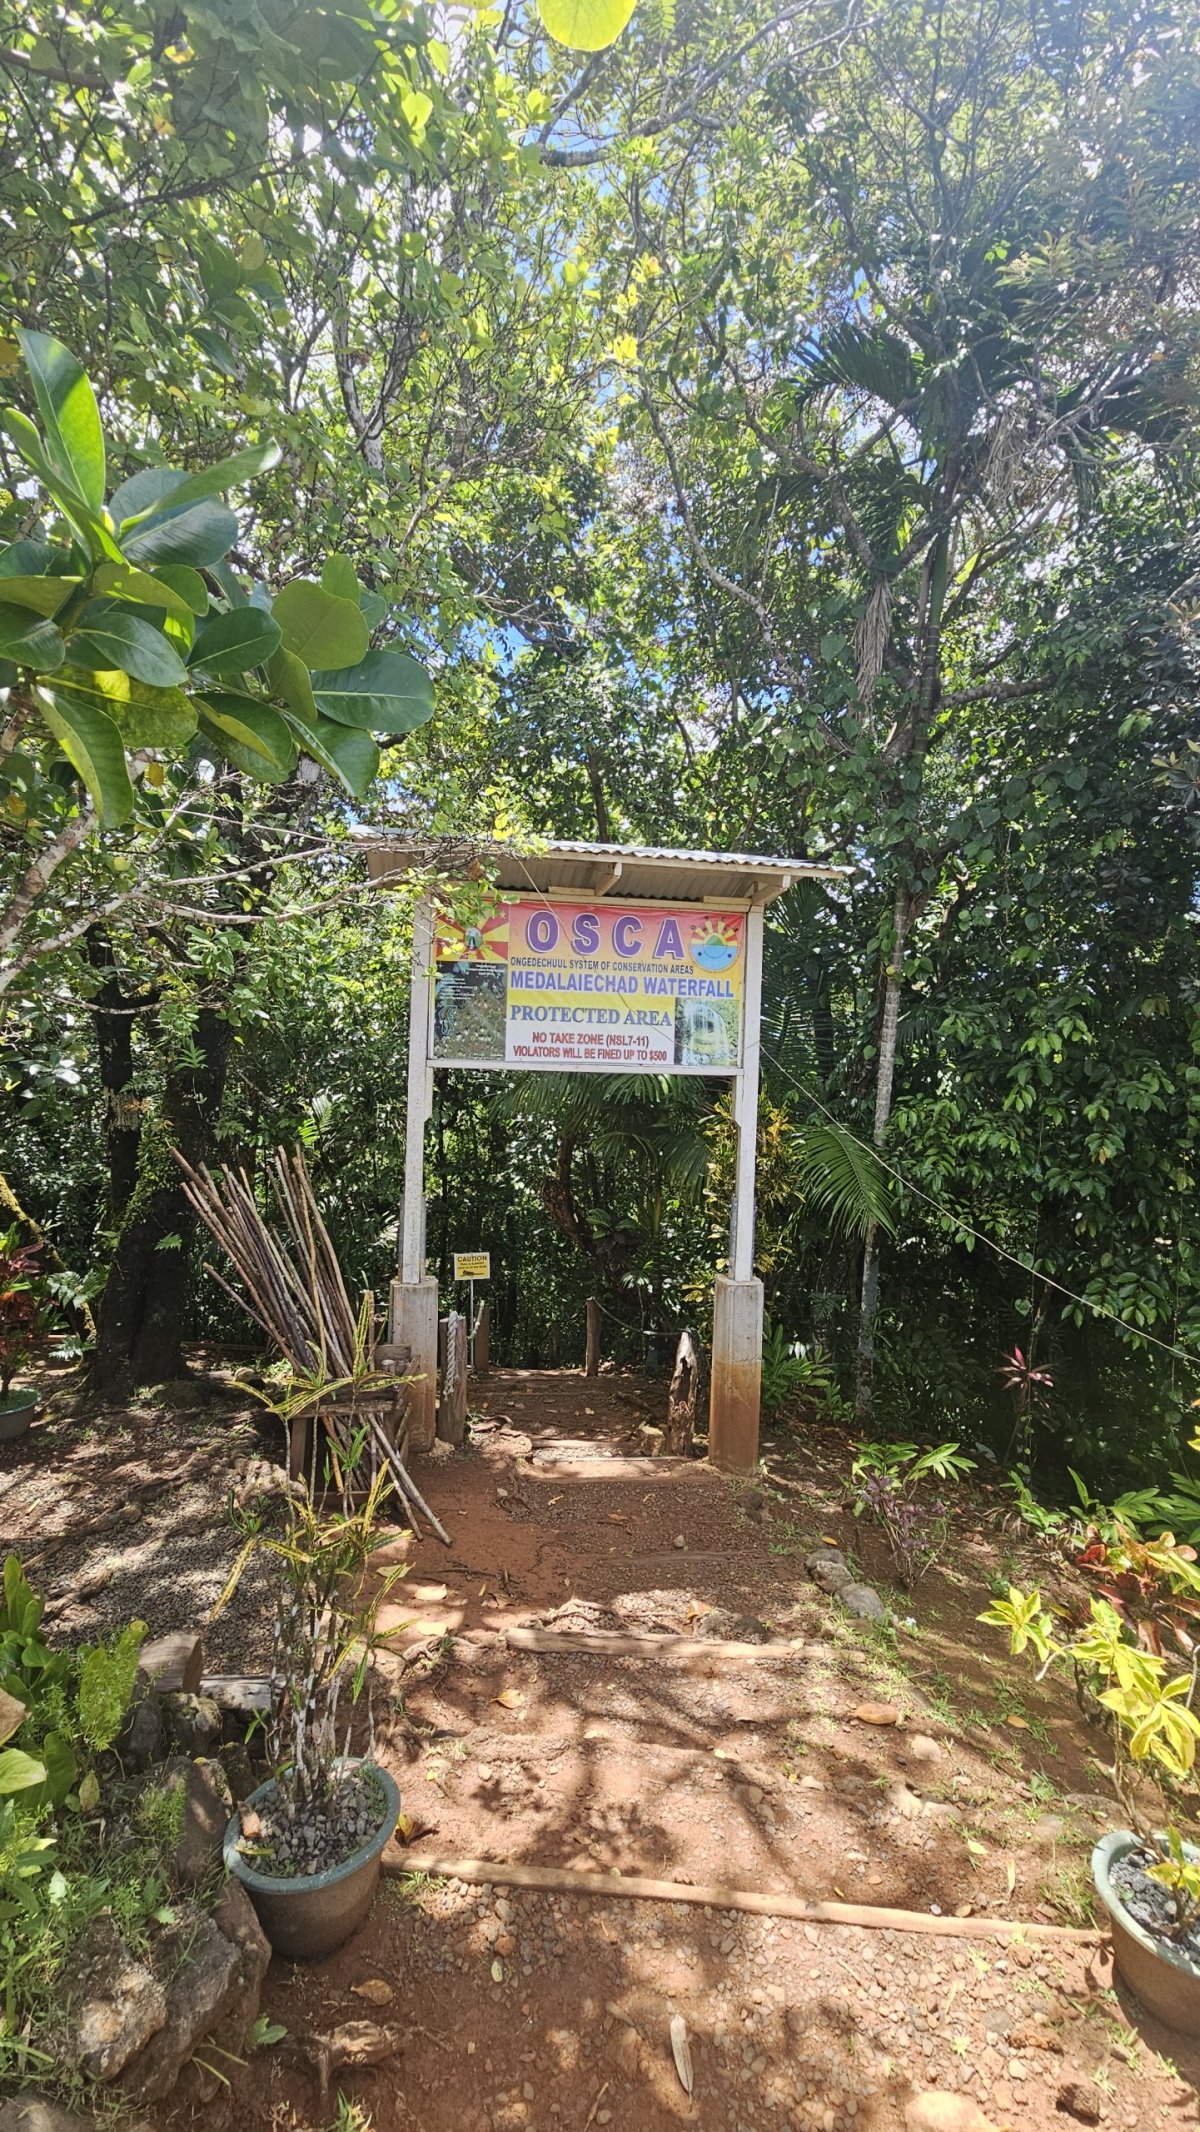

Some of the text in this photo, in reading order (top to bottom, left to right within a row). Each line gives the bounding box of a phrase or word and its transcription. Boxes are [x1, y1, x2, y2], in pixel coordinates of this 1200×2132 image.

[526, 910, 685, 960] OSCA
[510, 956, 567, 969] ONGEDECHUUL
[569, 959, 599, 970] SYSTEM
[600, 961, 610, 971] OF
[612, 961, 668, 974] CONSERVATION
[670, 964, 694, 975] AREAS
[510, 970, 734, 998] MEDALAIECHAD WATERFALL
[510, 1004, 673, 1026] PROTECTED AREA
[532, 1031, 650, 1049] NO TAKE ZONE (NSL7-11)
[513, 1045, 667, 1062] VIOLATORS WILL BE FINED UP TO $500
